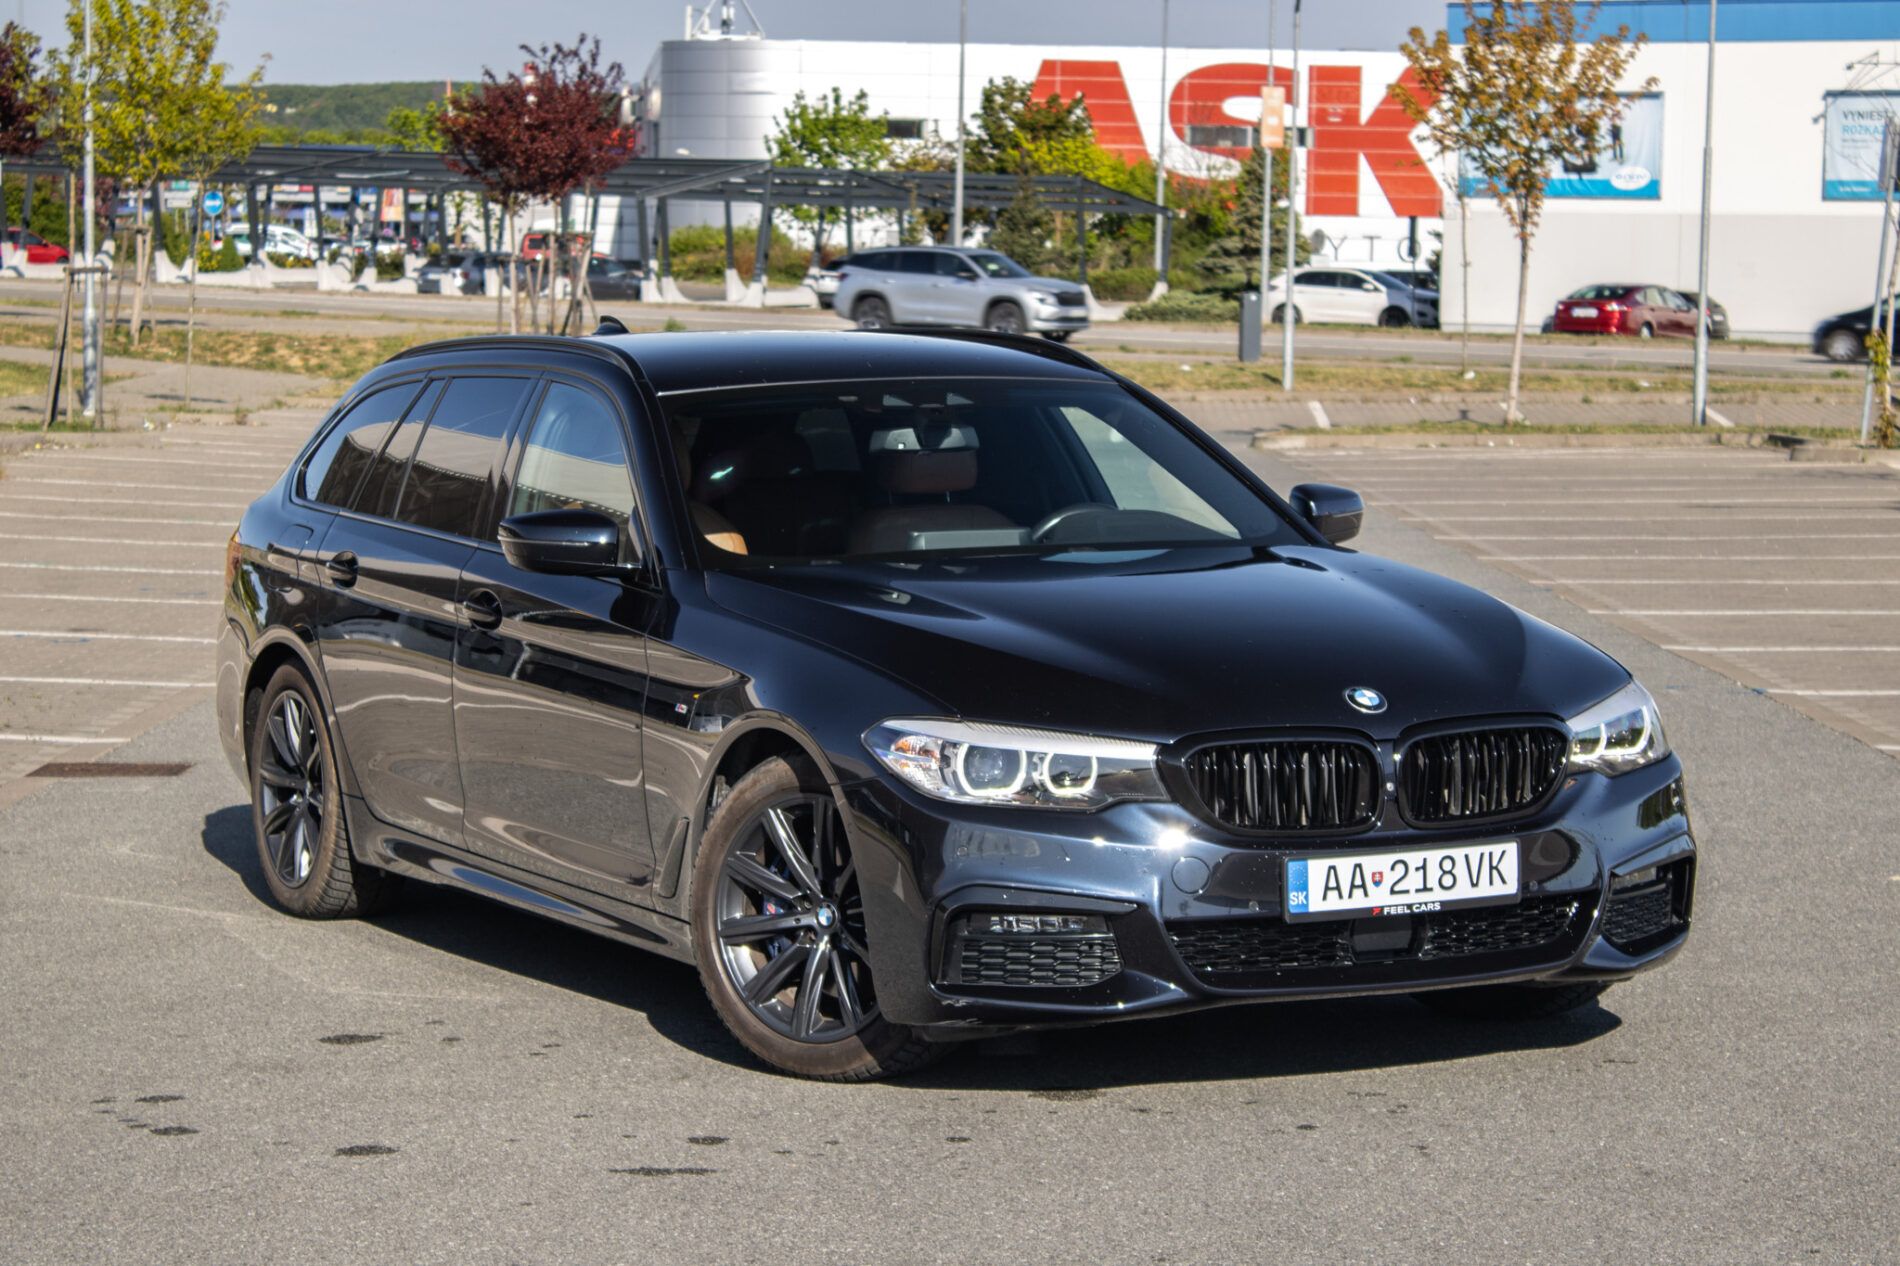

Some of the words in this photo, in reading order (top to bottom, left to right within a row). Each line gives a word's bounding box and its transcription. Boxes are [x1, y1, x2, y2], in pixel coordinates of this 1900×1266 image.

[1321, 862, 1370, 902] AA
[1389, 849, 1508, 896] 218VK
[1289, 891, 1308, 906] SK
[1383, 904, 1411, 916] FEEL
[1412, 901, 1441, 913] CARS
